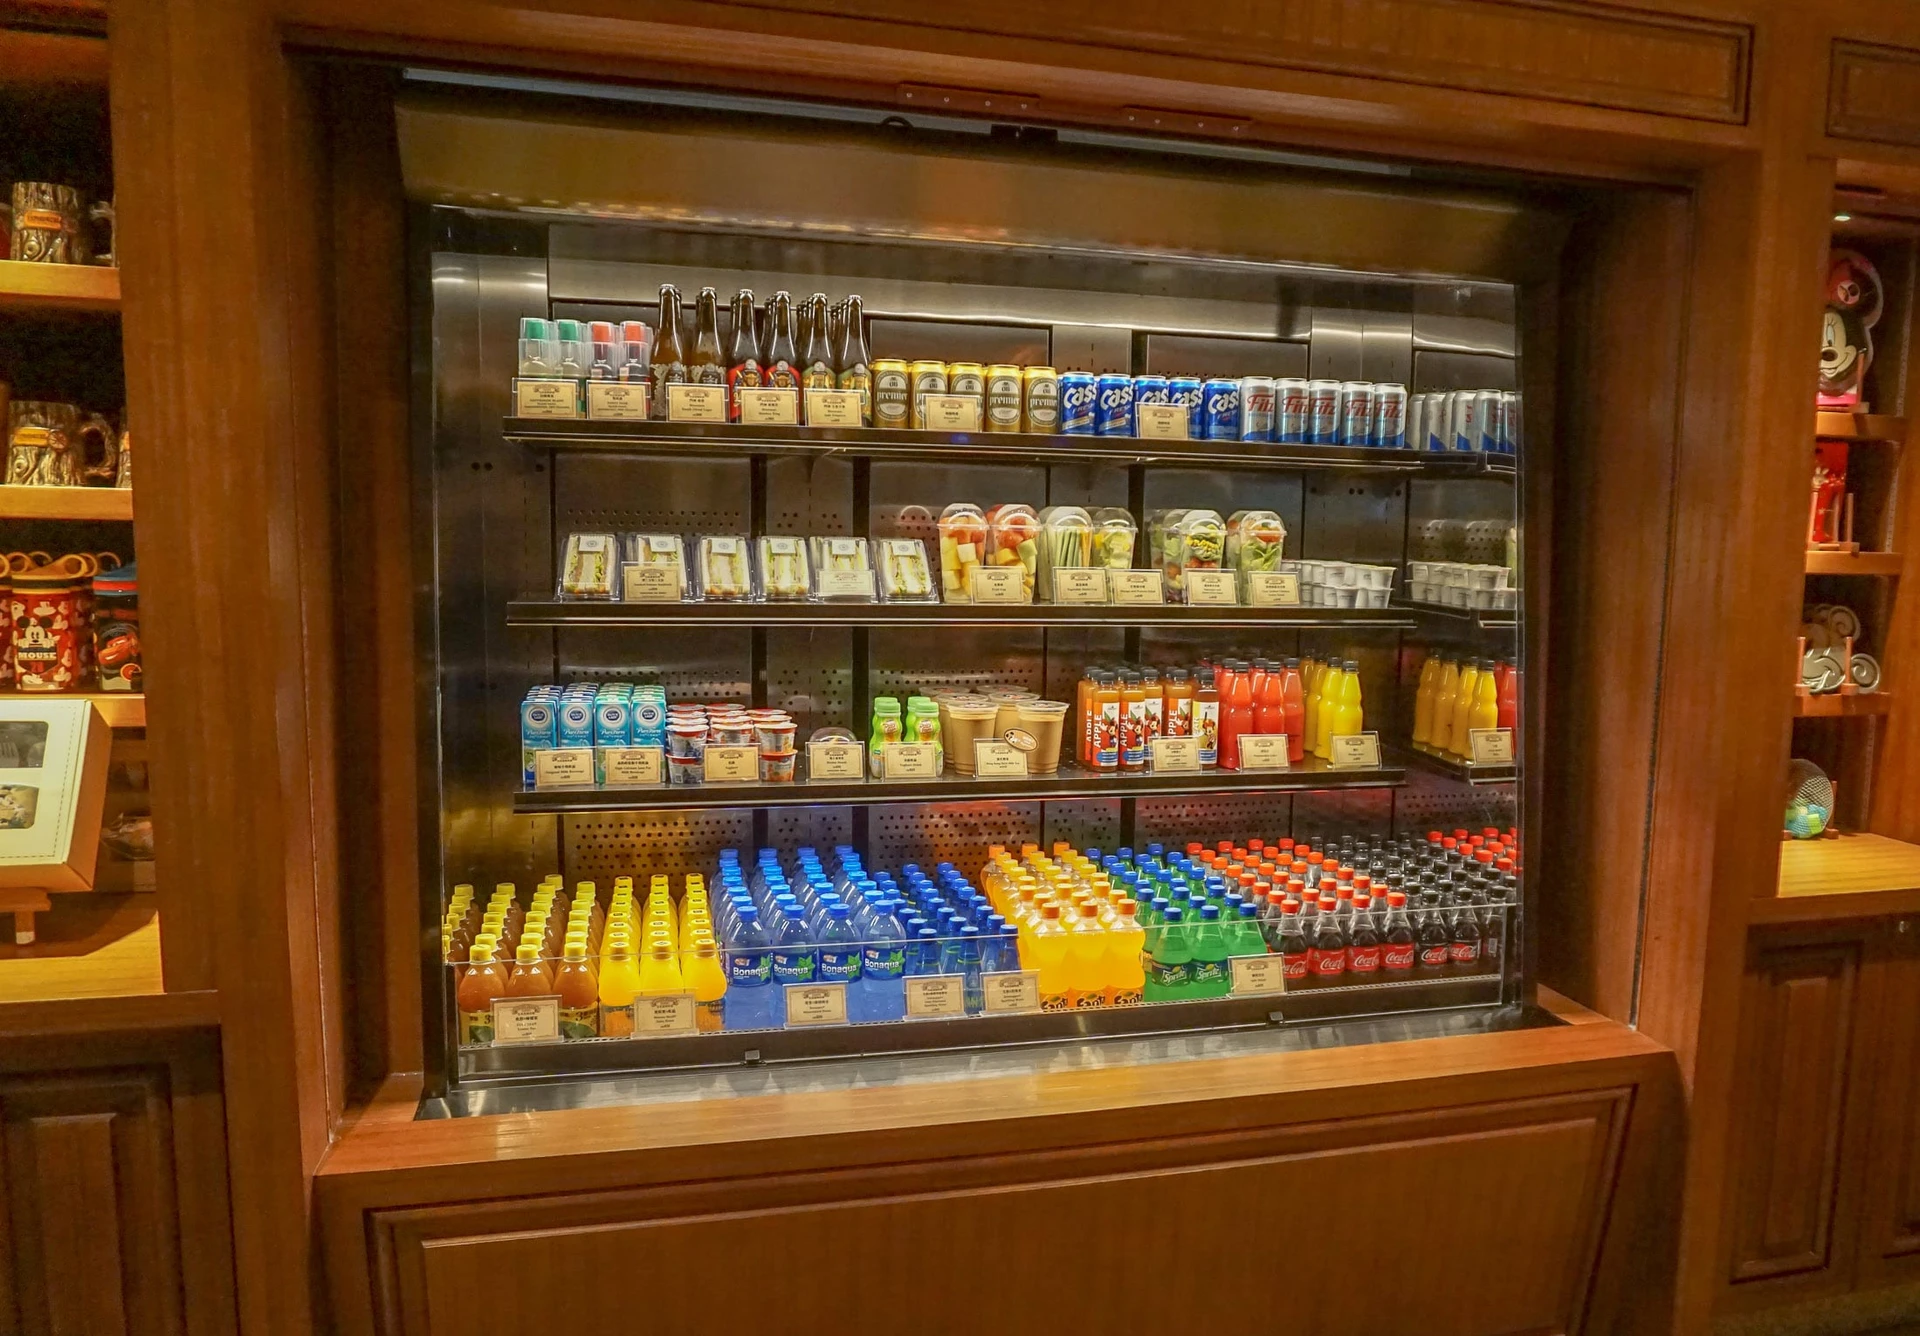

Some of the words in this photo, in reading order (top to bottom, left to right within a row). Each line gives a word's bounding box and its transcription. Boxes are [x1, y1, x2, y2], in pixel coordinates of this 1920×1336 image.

[1168, 709, 1178, 737] PPLE
[1094, 714, 1102, 748] APPLE
[1120, 713, 1128, 747] APPLE
[773, 964, 809, 976] Bonaqua
[821, 963, 857, 976] Bonaqua
[864, 957, 900, 971] Bonaqua
[733, 965, 770, 978] Bonaqua
[1164, 971, 1187, 983] Sprite
[1198, 967, 1221, 980] Sprite
